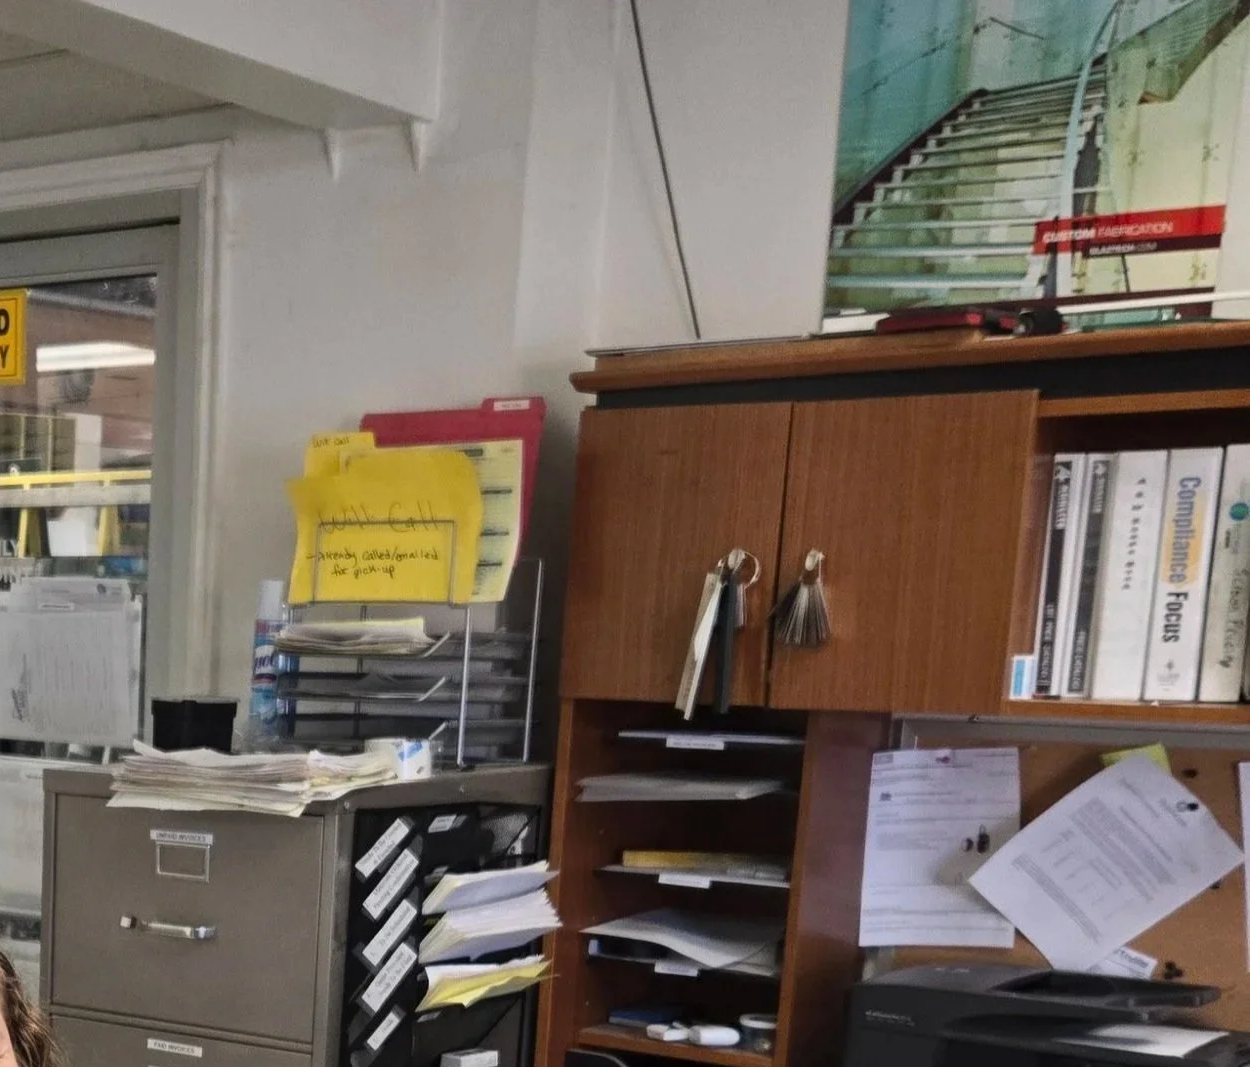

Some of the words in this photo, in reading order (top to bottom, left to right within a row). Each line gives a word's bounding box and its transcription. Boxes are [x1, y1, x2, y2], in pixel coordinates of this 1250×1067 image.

[1043, 229, 1096, 243] CUSTOM
[1098, 222, 1174, 238] FABRICATION
[1169, 476, 1202, 584] Compliance
[1162, 592, 1189, 643] Focus
